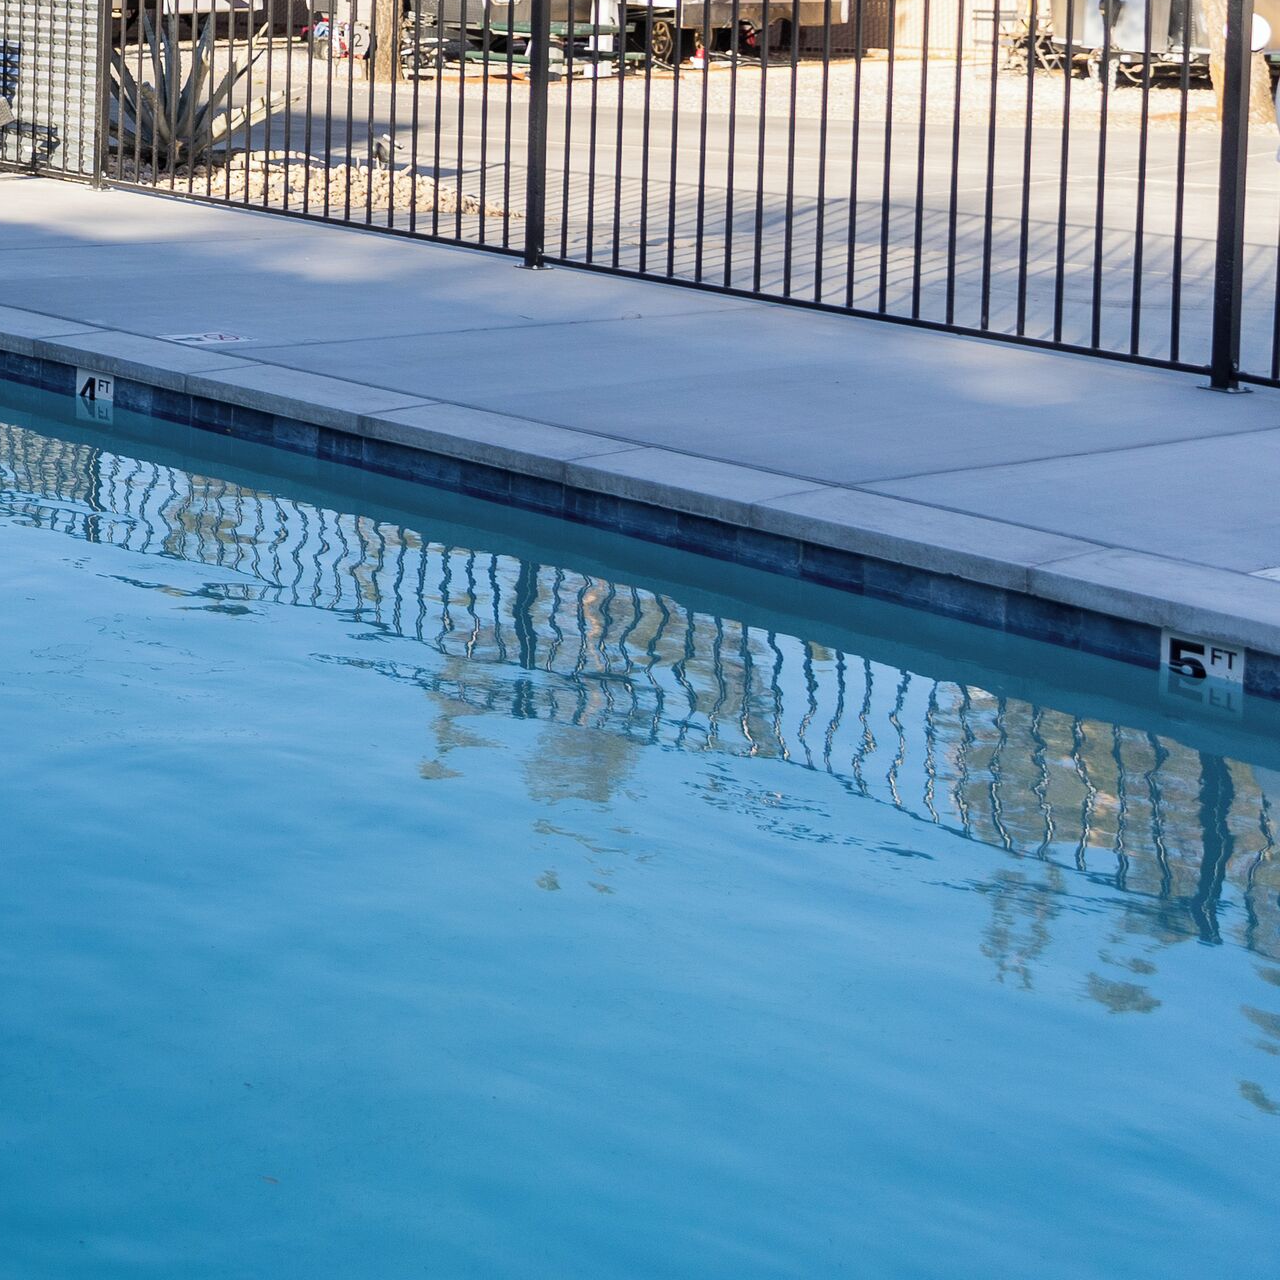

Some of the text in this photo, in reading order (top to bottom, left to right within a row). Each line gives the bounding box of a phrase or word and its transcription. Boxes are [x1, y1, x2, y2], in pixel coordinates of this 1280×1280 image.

[98, 379, 112, 394] FT
[1169, 637, 1238, 680] 5 FT
